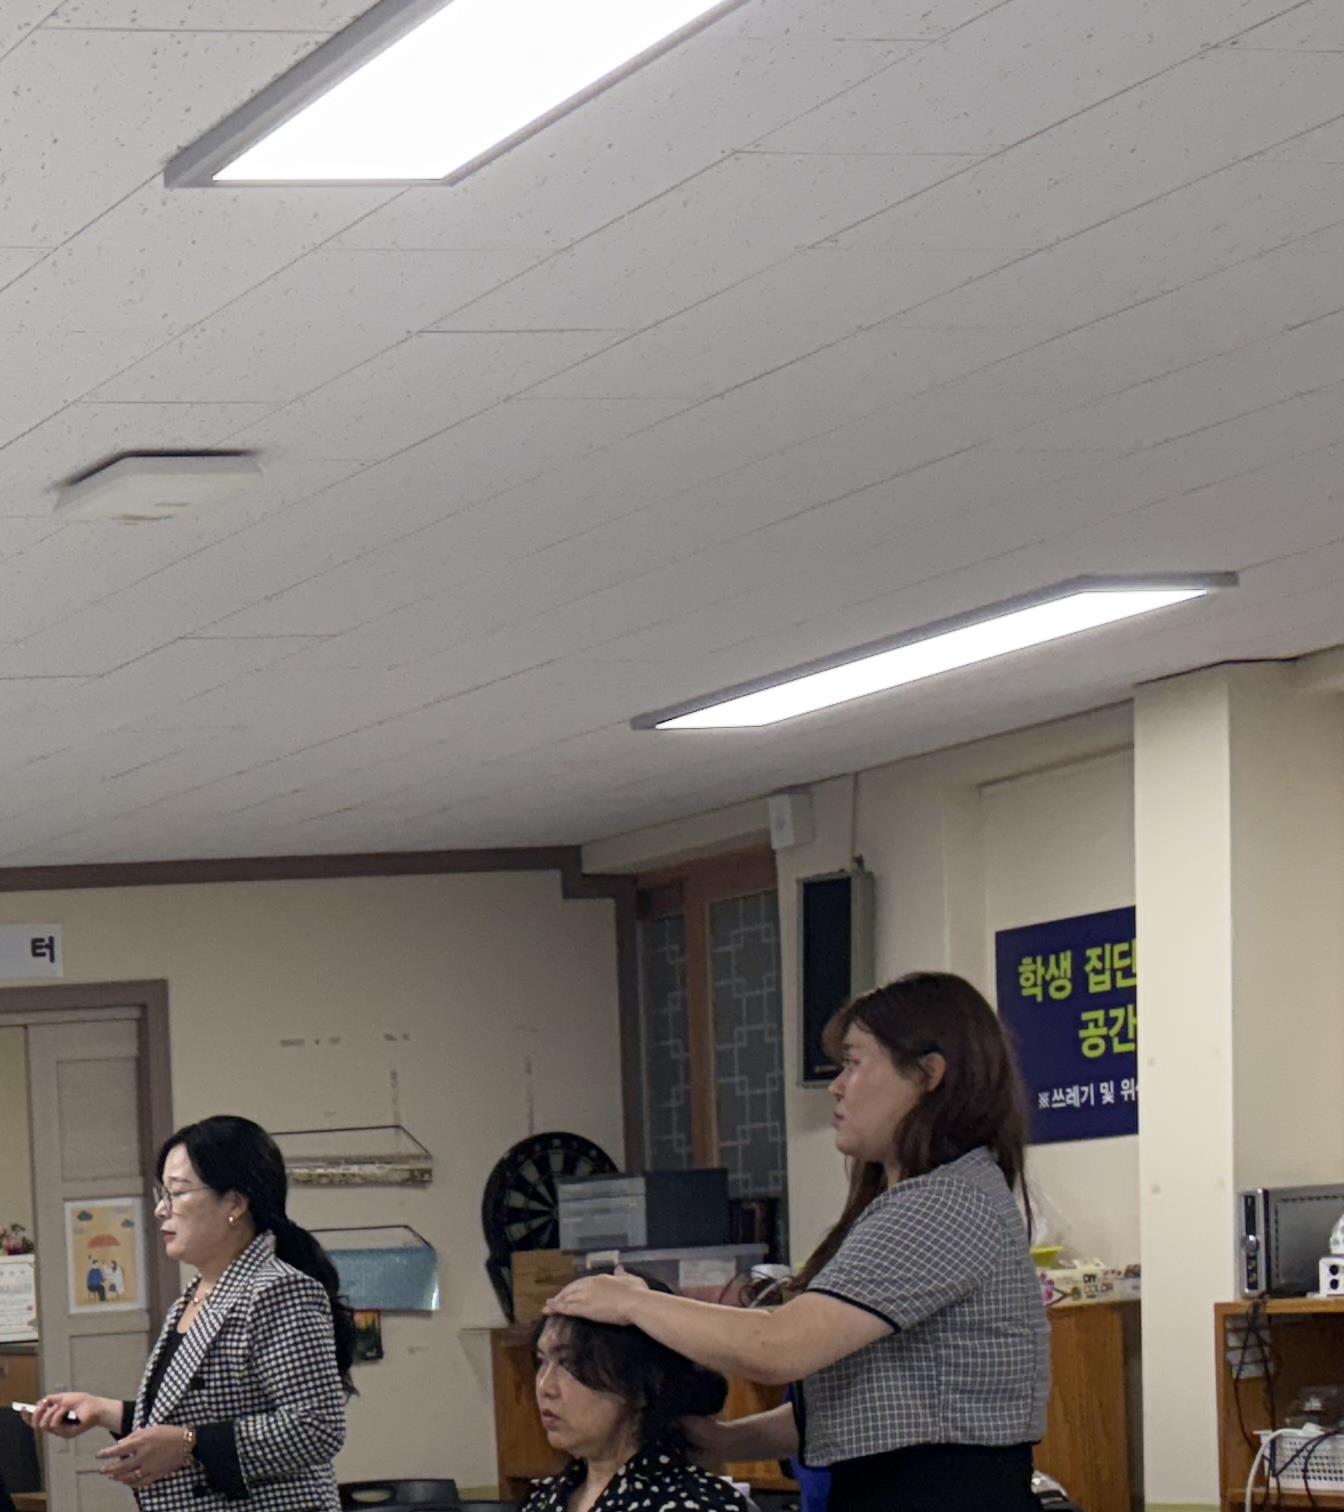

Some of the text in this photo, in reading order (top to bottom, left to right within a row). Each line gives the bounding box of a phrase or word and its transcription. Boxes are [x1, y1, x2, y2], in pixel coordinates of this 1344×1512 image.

[31, 936, 55, 963] 터
[1018, 949, 1072, 1002] 학생
[1078, 1004, 1138, 1059] 공간
[1099, 1080, 1115, 1104] 및
